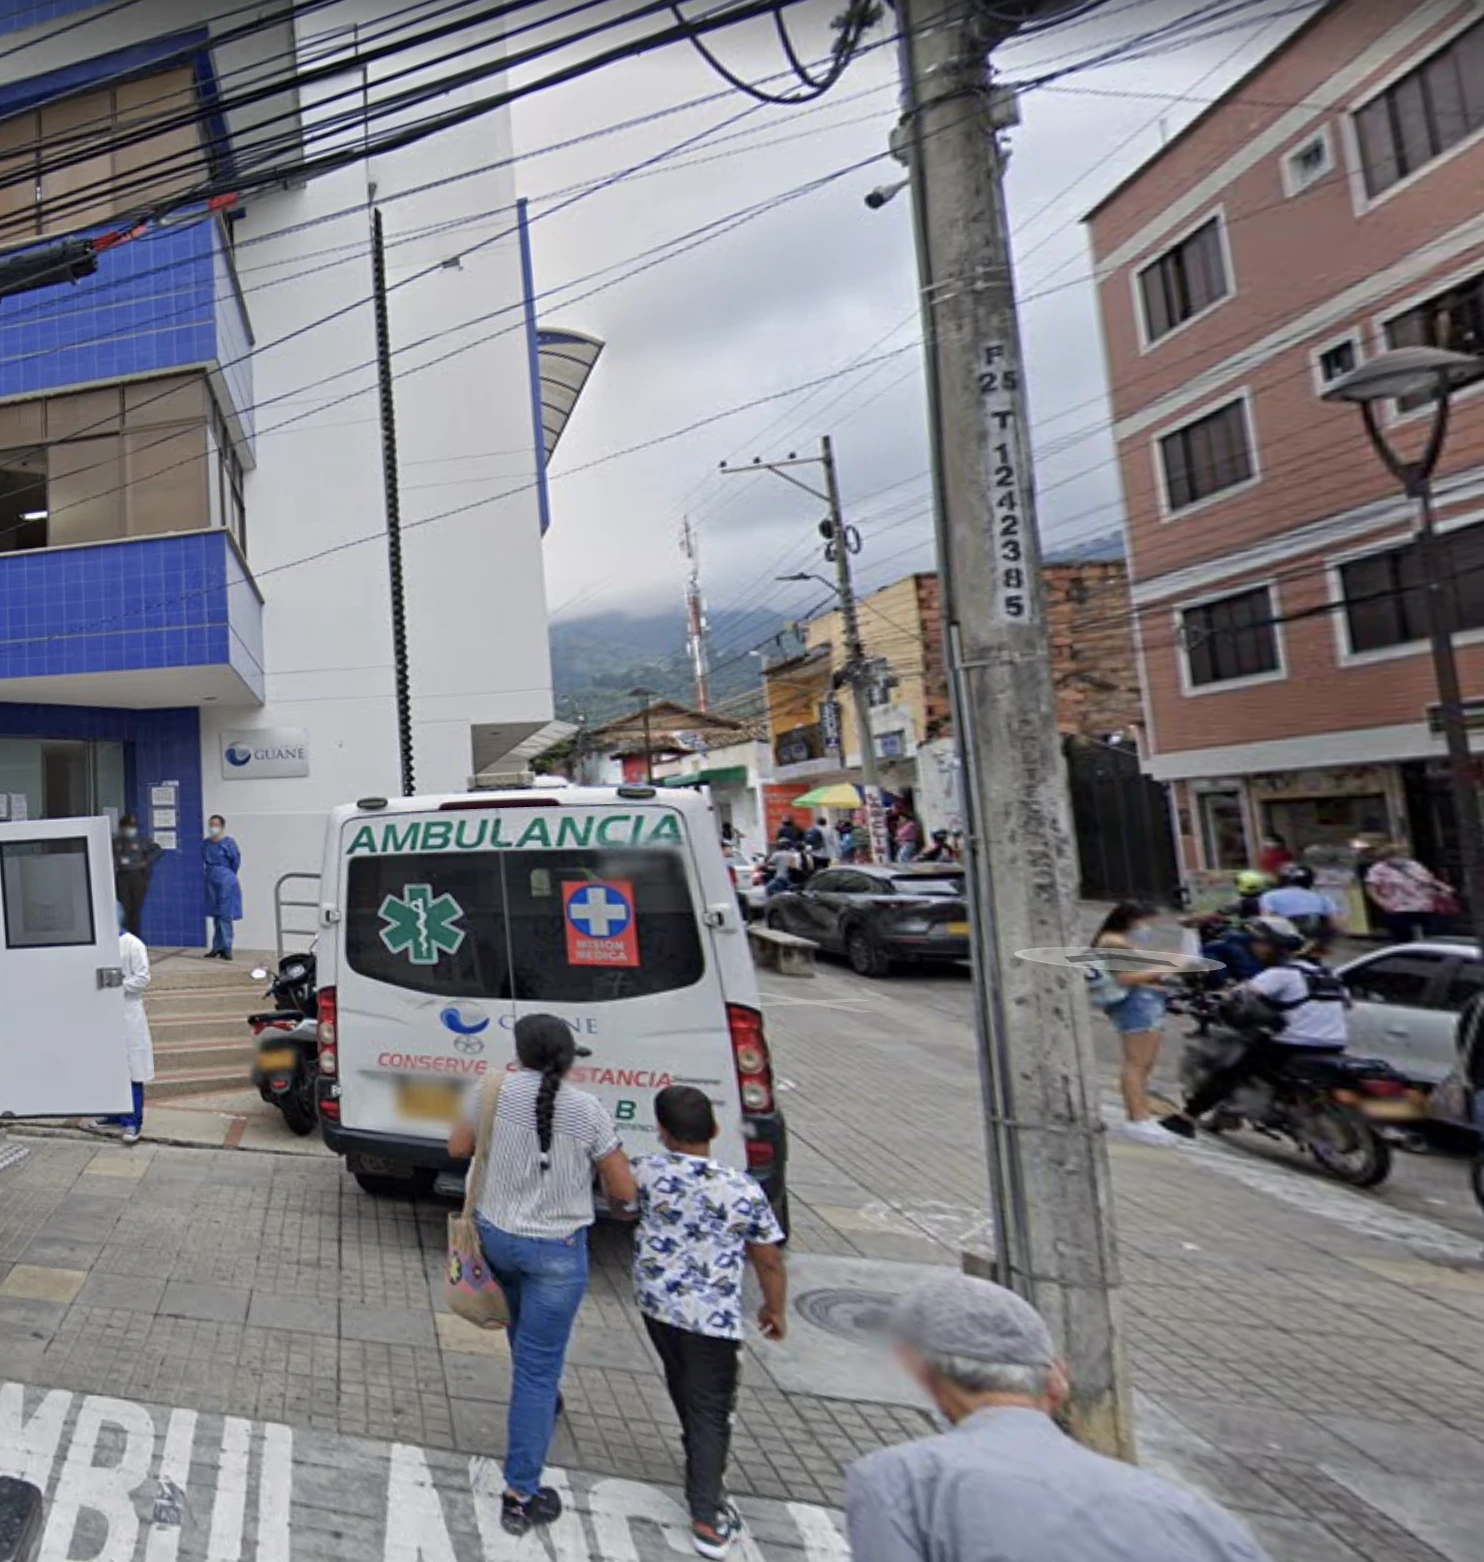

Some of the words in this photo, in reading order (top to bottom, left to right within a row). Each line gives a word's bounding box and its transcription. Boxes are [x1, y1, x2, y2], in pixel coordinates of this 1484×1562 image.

[978, 370, 1017, 393] 25
[254, 748, 304, 760] GUANE
[346, 814, 683, 854] AMBULANCIA
[378, 1053, 487, 1075] CONSERVE
[569, 1066, 672, 1089] STANCIA
